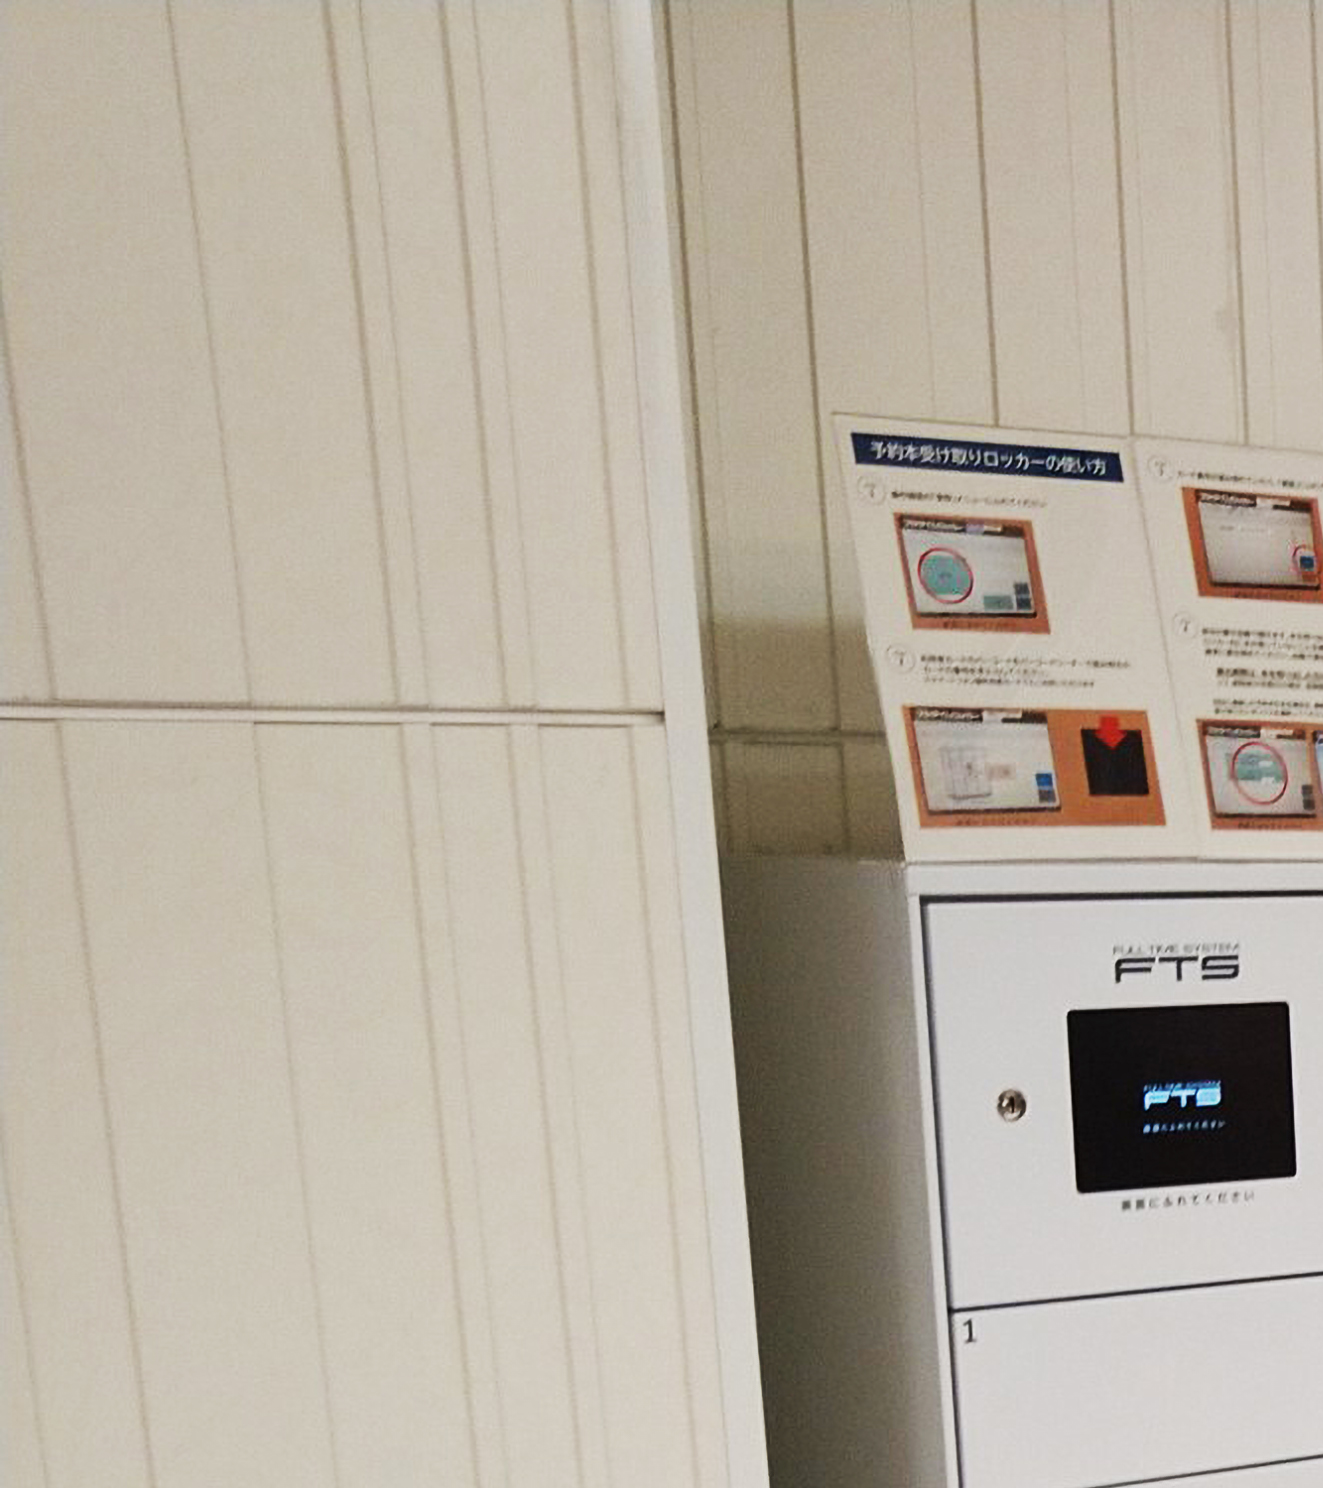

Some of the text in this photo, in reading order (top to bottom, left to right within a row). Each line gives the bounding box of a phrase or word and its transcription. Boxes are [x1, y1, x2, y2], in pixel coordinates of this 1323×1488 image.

[870, 441, 1108, 476] 予約本受け取りロッカーの使い方
[1114, 955, 1239, 983] FTS
[1143, 1087, 1222, 1111] FTS
[963, 1319, 977, 1344] 1
